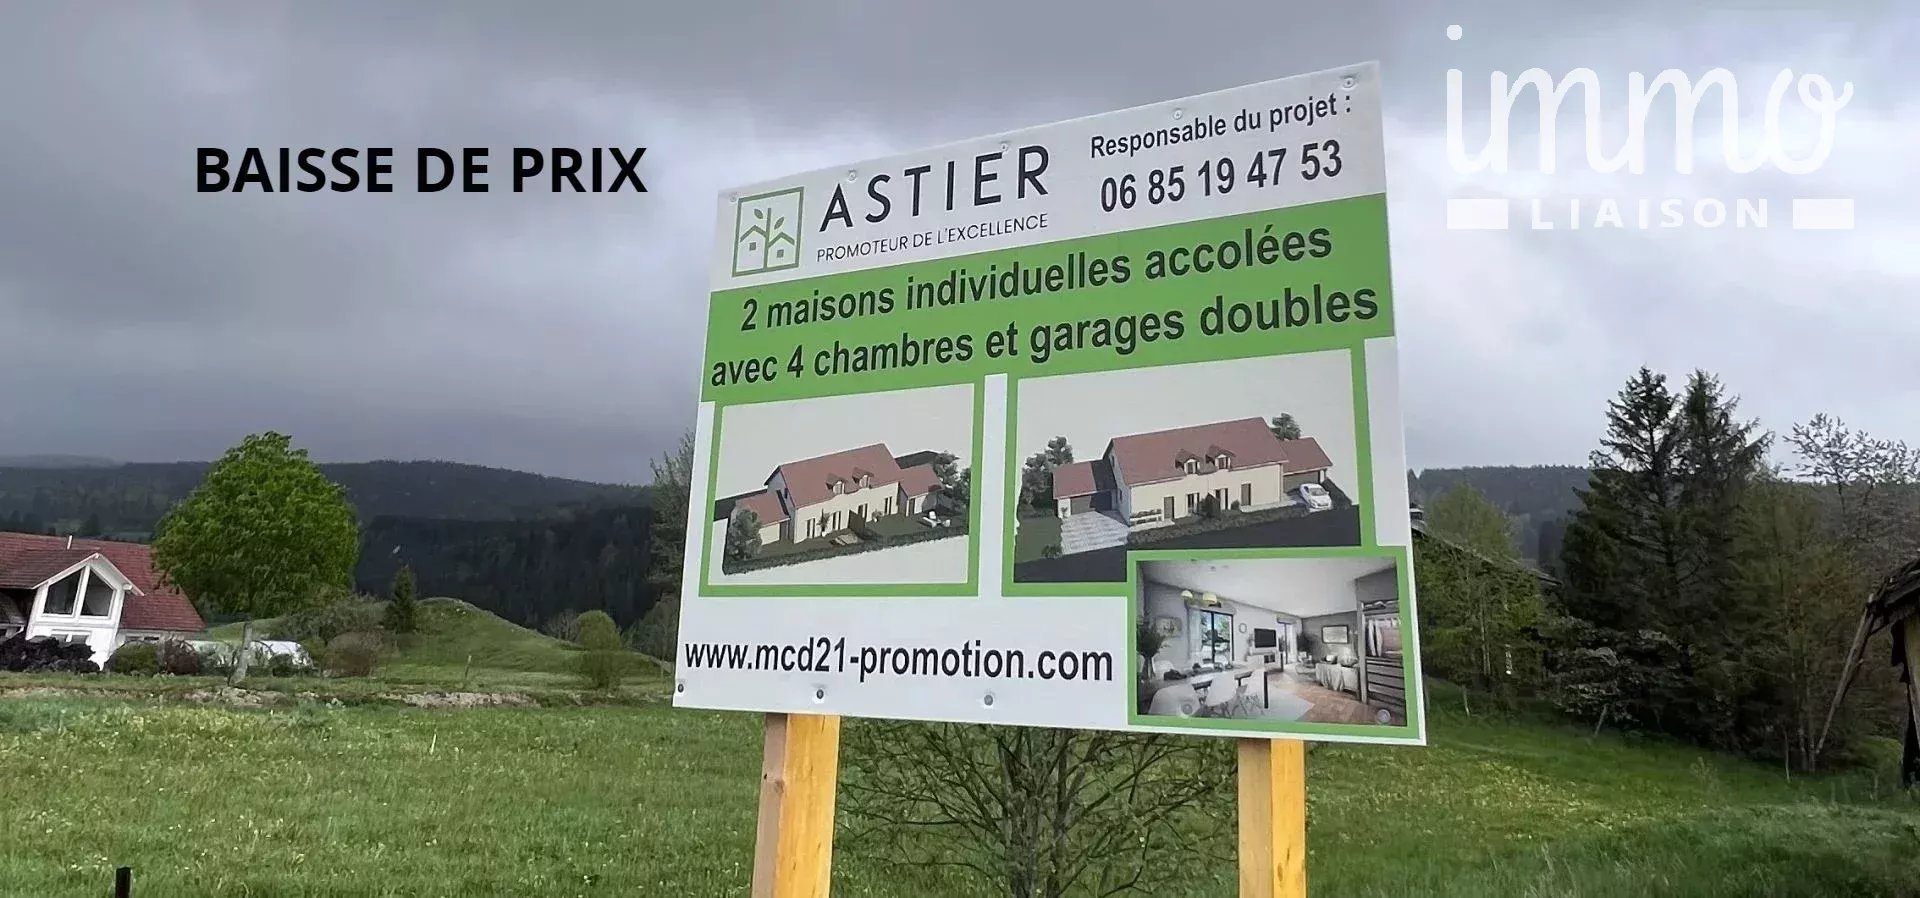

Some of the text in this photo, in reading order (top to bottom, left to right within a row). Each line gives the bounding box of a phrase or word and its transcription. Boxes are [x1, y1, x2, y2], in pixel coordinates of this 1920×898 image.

[1090, 115, 1227, 159] Responsable
[1233, 109, 1262, 132] du
[1269, 94, 1338, 132] projet
[819, 144, 1050, 233] ASTIER
[1100, 138, 1343, 213] 06 85 19 47 53
[816, 213, 1049, 263] PROMOTEUR DE L'EXCELLENCE
[741, 224, 1333, 331] 2 maisons individuelles accolées
[711, 283, 1380, 387] avec 4 chambres et garages doubles
[684, 637, 1113, 682] www.mcd21-promotion.com
